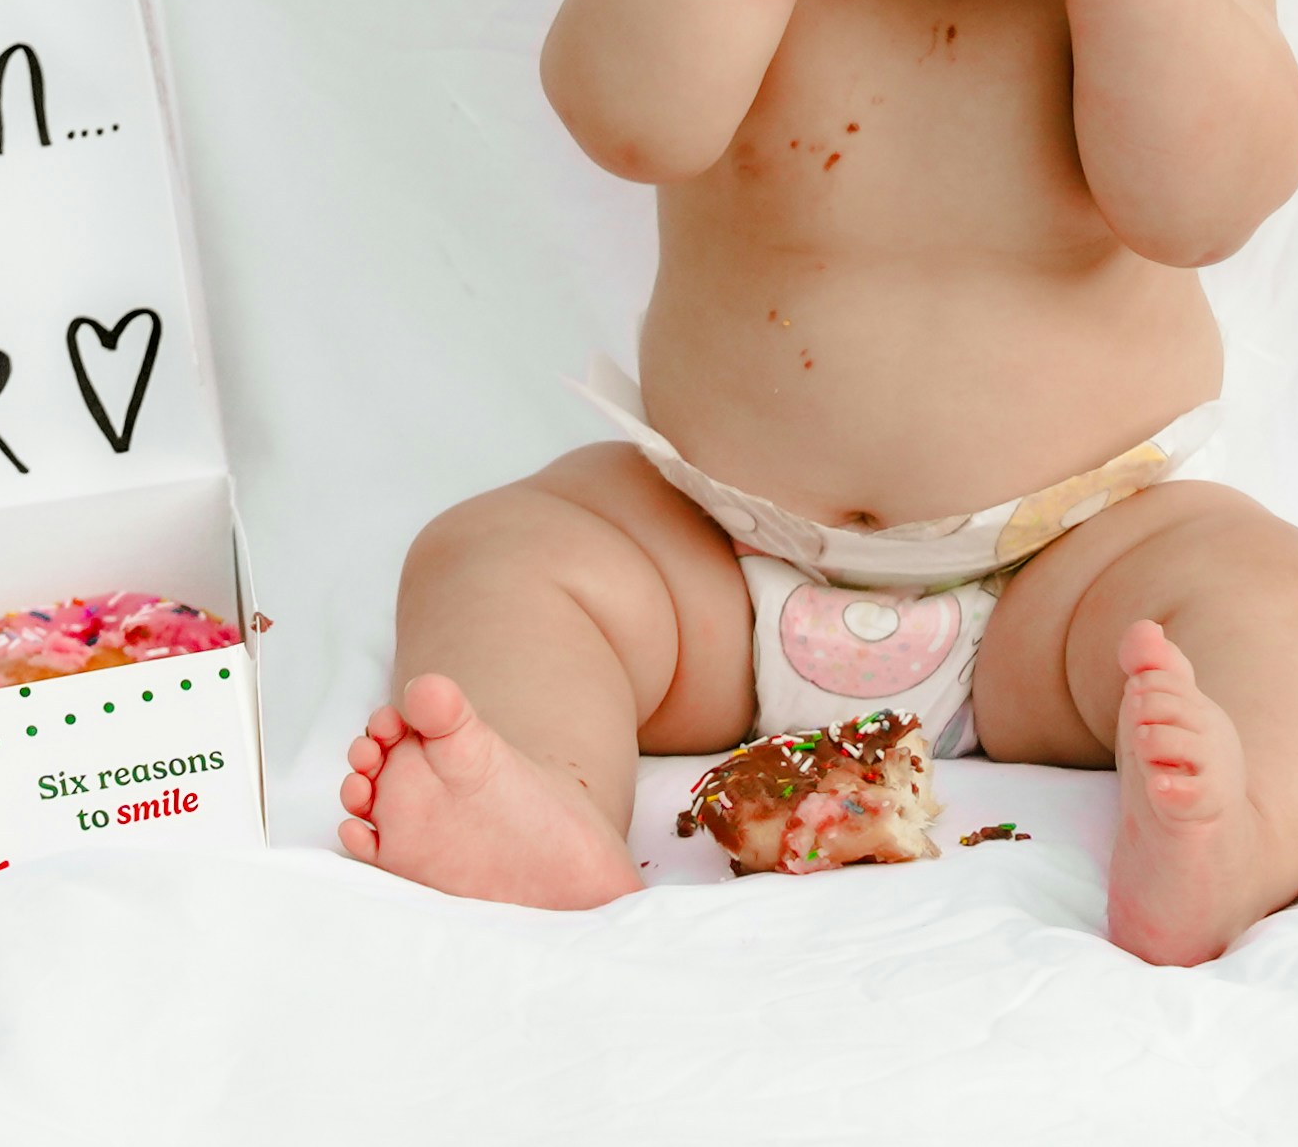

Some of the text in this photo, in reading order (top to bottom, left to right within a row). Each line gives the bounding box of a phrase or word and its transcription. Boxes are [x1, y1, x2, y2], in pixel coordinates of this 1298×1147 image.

[38, 749, 226, 802] Six reasons
[76, 788, 200, 831] to smile
